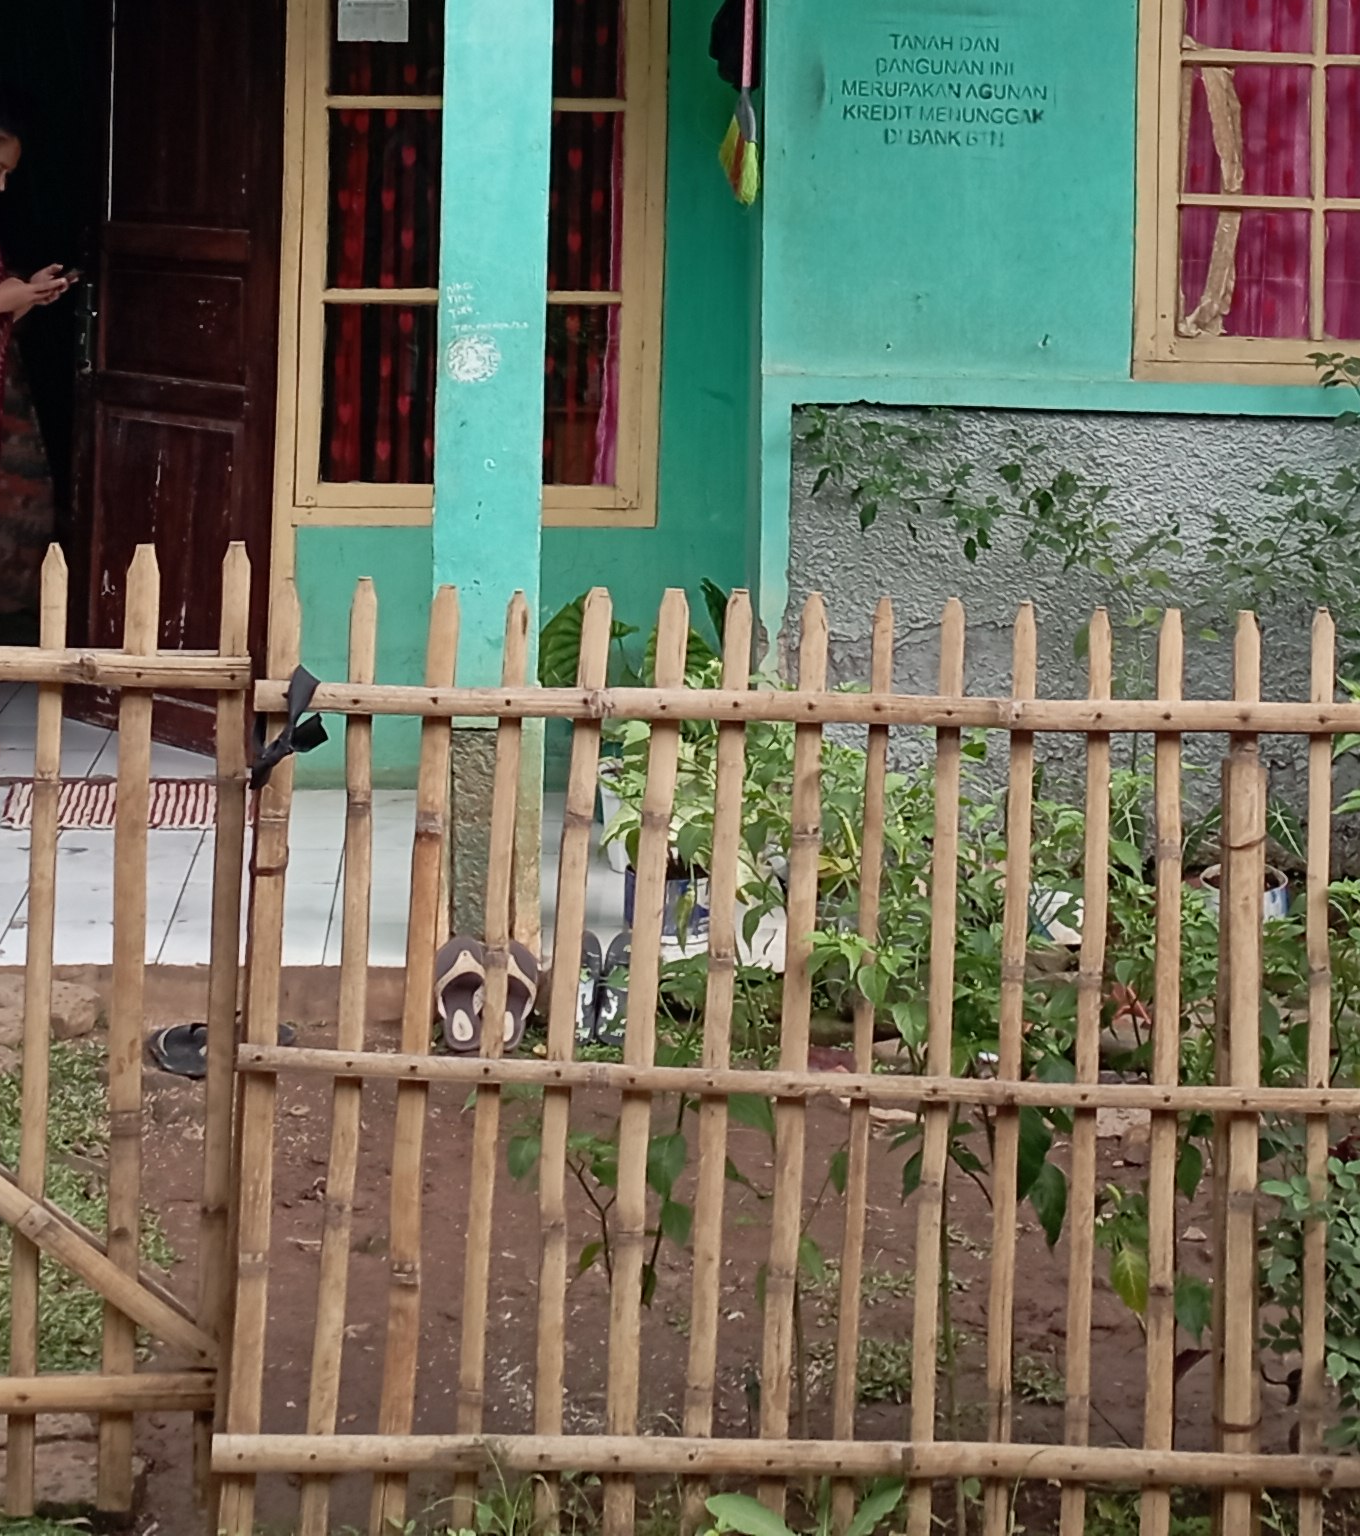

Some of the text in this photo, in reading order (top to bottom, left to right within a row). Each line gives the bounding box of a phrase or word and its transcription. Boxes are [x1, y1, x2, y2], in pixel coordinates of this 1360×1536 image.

[889, 33, 1000, 53] TANAH DAN
[876, 57, 1014, 76] BANGUNAN INI
[841, 79, 1047, 101] MERUPAKAN AGUNAN
[842, 104, 1044, 125] KREDIT MENUNGGAK
[908, 129, 961, 147] BANK
